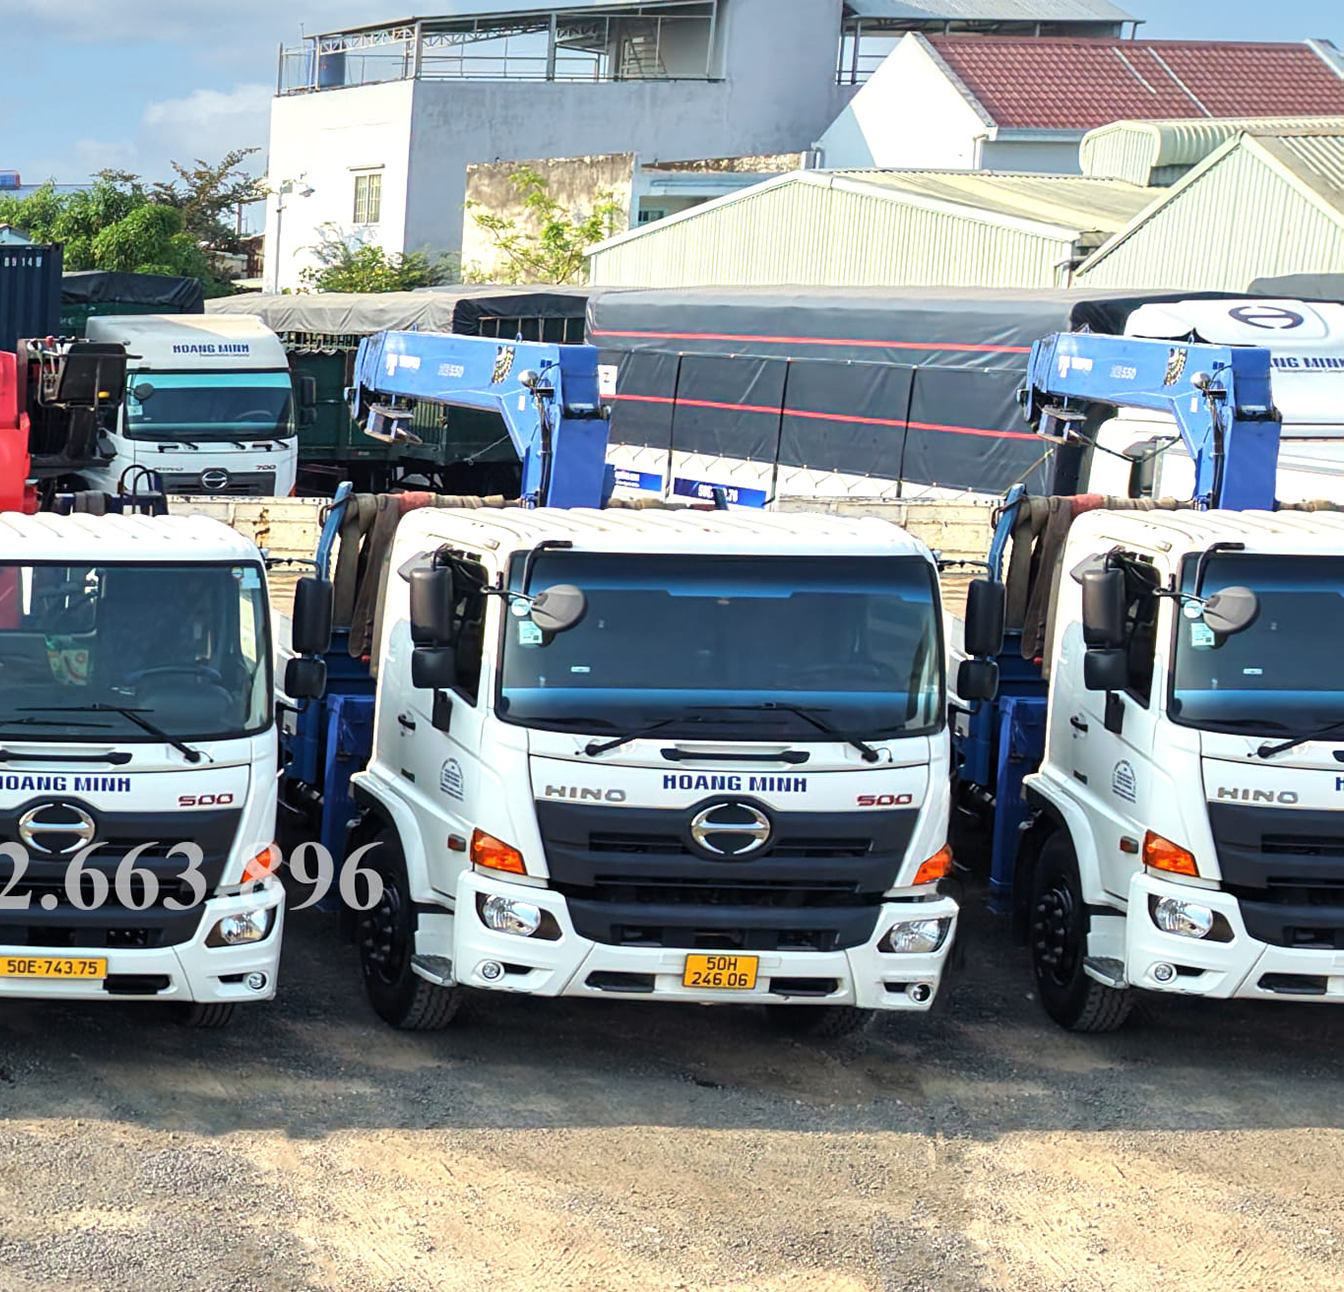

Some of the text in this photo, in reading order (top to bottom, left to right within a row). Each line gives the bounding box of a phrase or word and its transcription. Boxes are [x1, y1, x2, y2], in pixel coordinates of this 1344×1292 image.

[172, 344, 250, 354] HOANG MINH
[74, 776, 131, 792] MINH
[662, 774, 808, 793] HOANG MINH
[178, 793, 234, 806] 500
[544, 785, 627, 801] HINO
[856, 793, 913, 806] 500
[1217, 786, 1299, 804] HINO
[6, 960, 98, 975] 50E-743.75
[706, 957, 738, 971] 50H
[691, 972, 748, 987] 246.06
